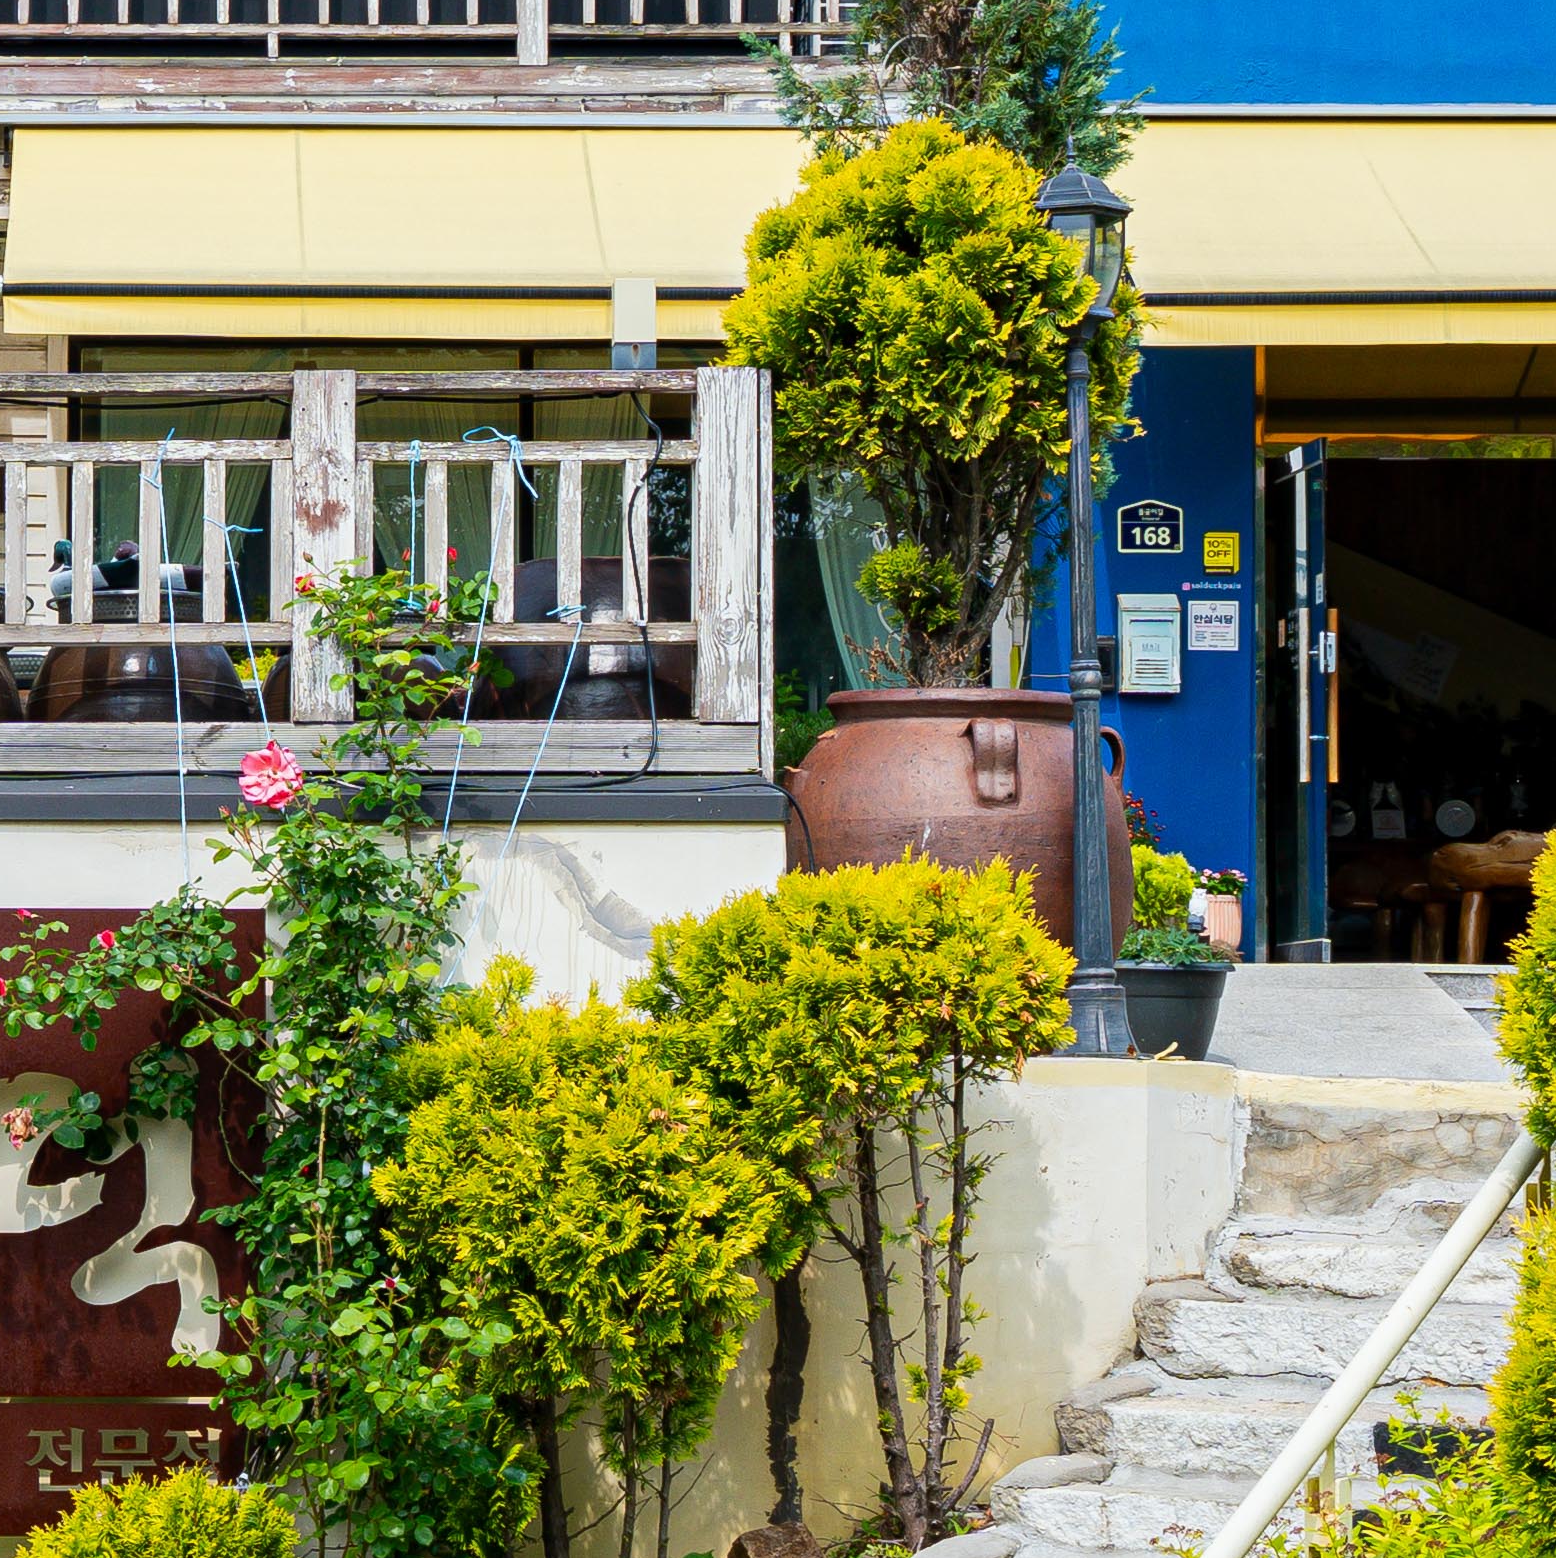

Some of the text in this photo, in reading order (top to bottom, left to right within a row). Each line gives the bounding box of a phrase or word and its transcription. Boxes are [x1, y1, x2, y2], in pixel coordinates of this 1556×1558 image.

[1131, 526, 1171, 546] 168
[1207, 539, 1232, 549] 10%
[1206, 549, 1231, 558] OFF
[1193, 614, 1234, 625] 안심식당
